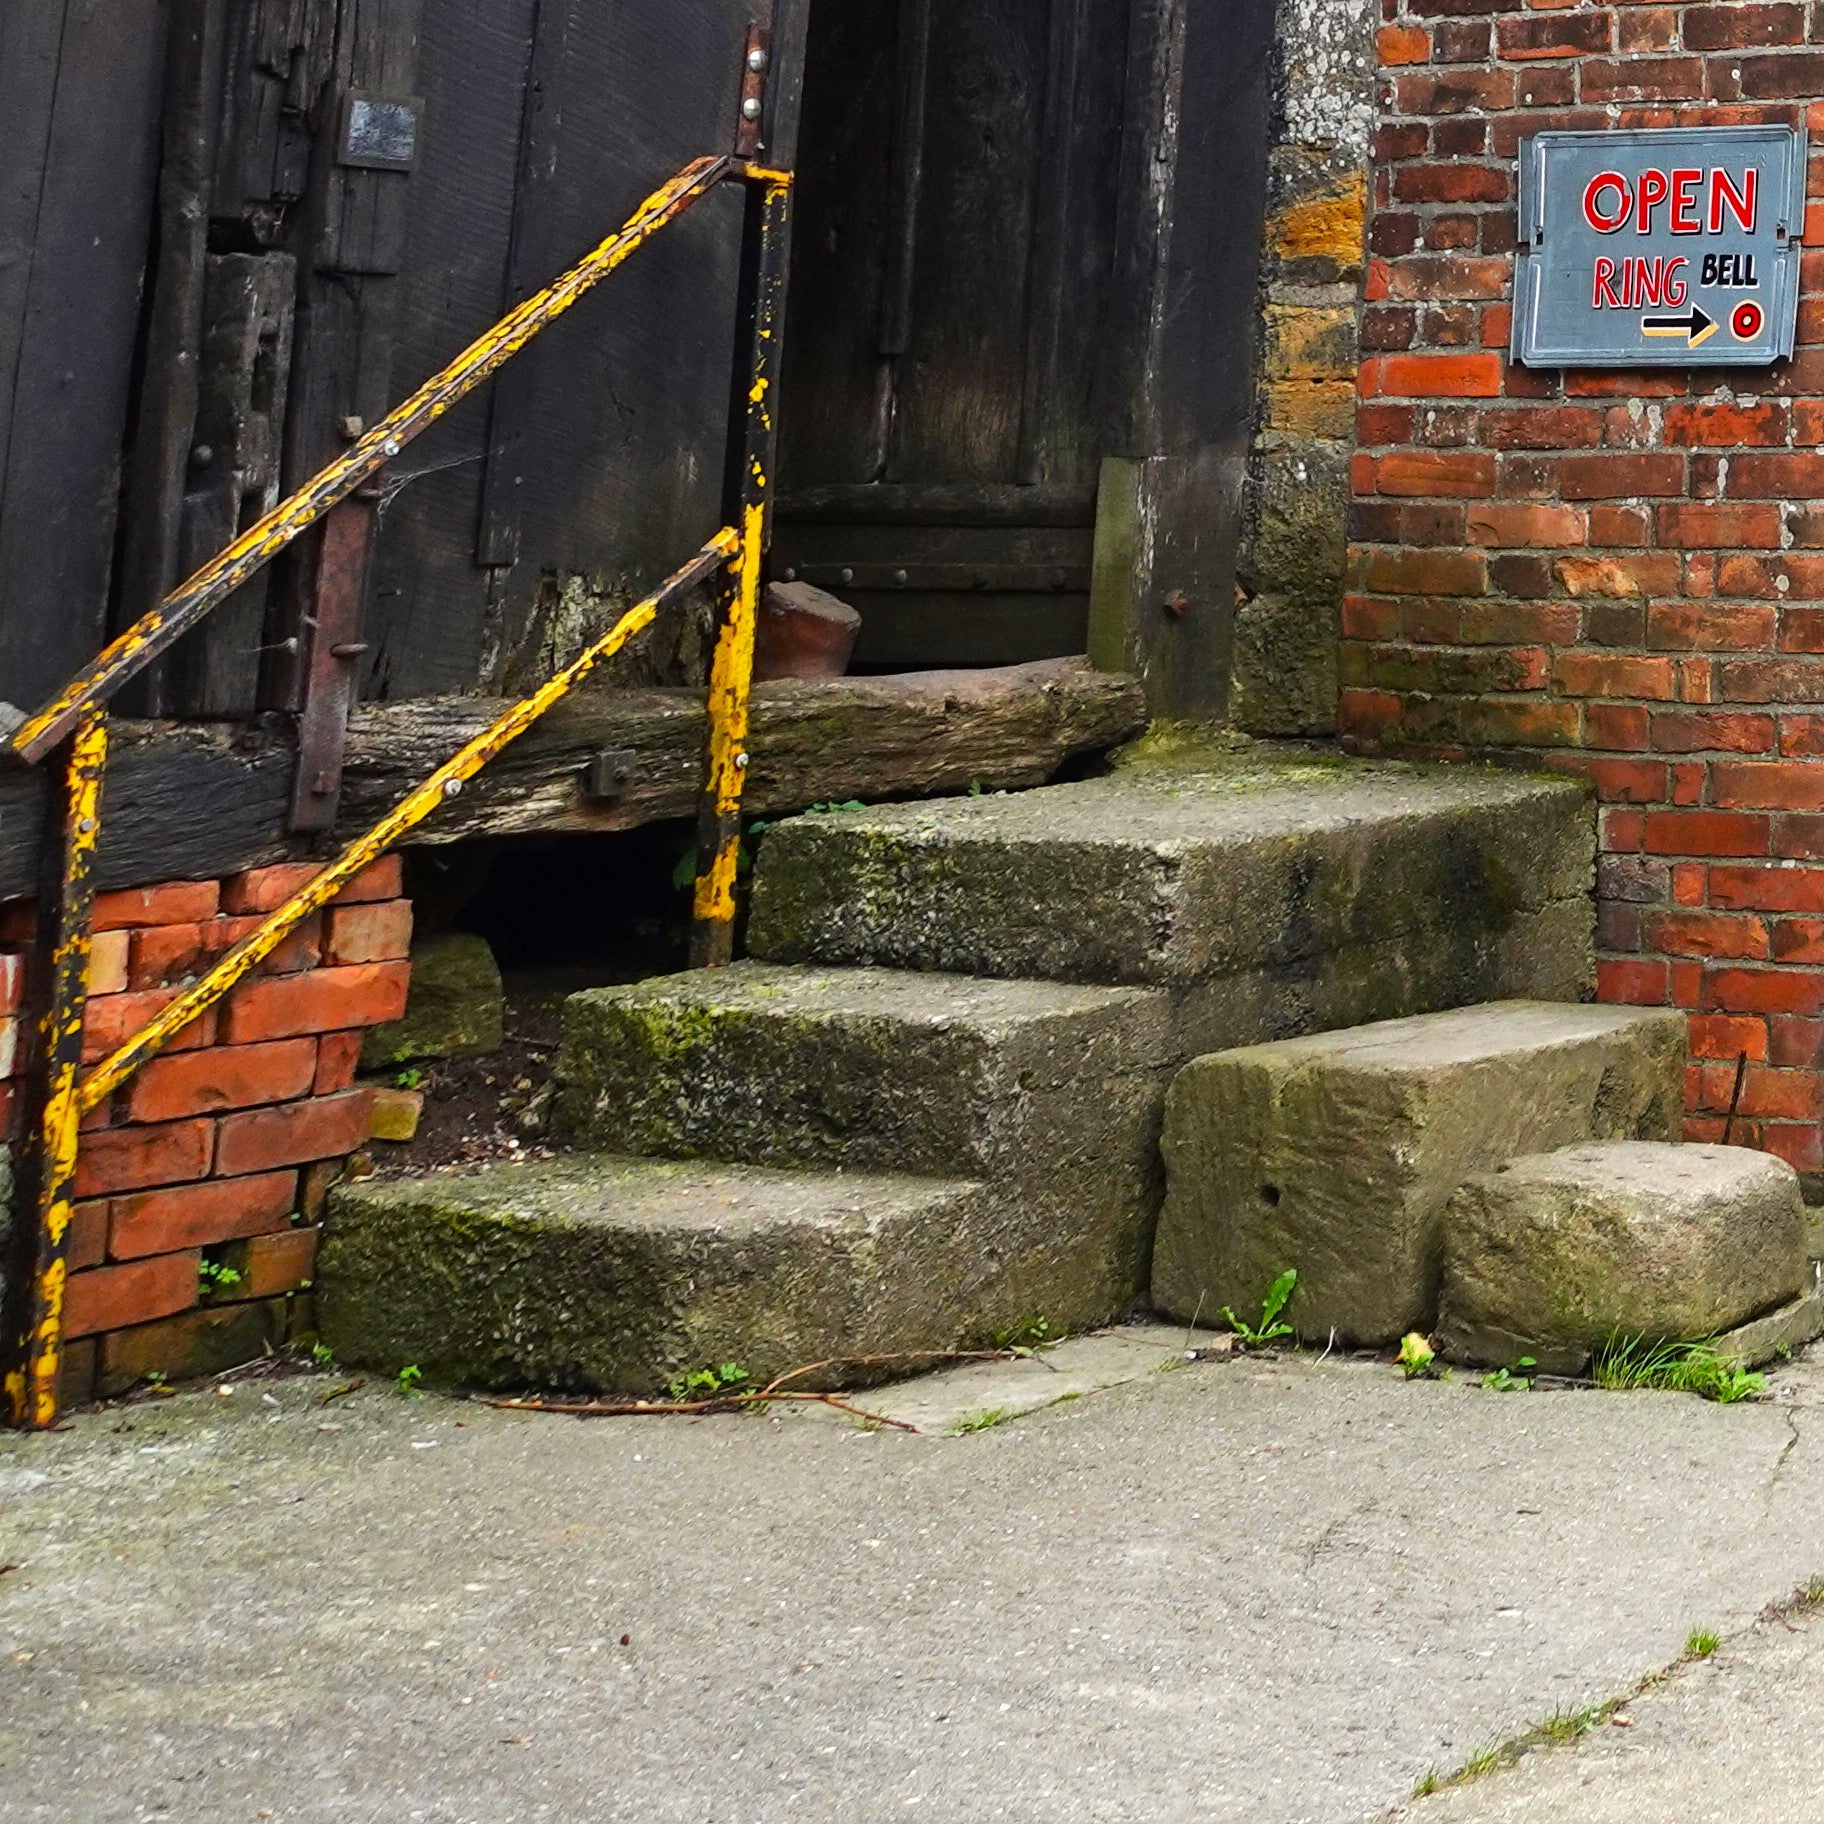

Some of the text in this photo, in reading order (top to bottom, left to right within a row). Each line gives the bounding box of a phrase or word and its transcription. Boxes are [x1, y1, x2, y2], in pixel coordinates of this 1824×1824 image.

[1582, 167, 1758, 234] OPEN
[1592, 253, 1759, 308] RING BELL
